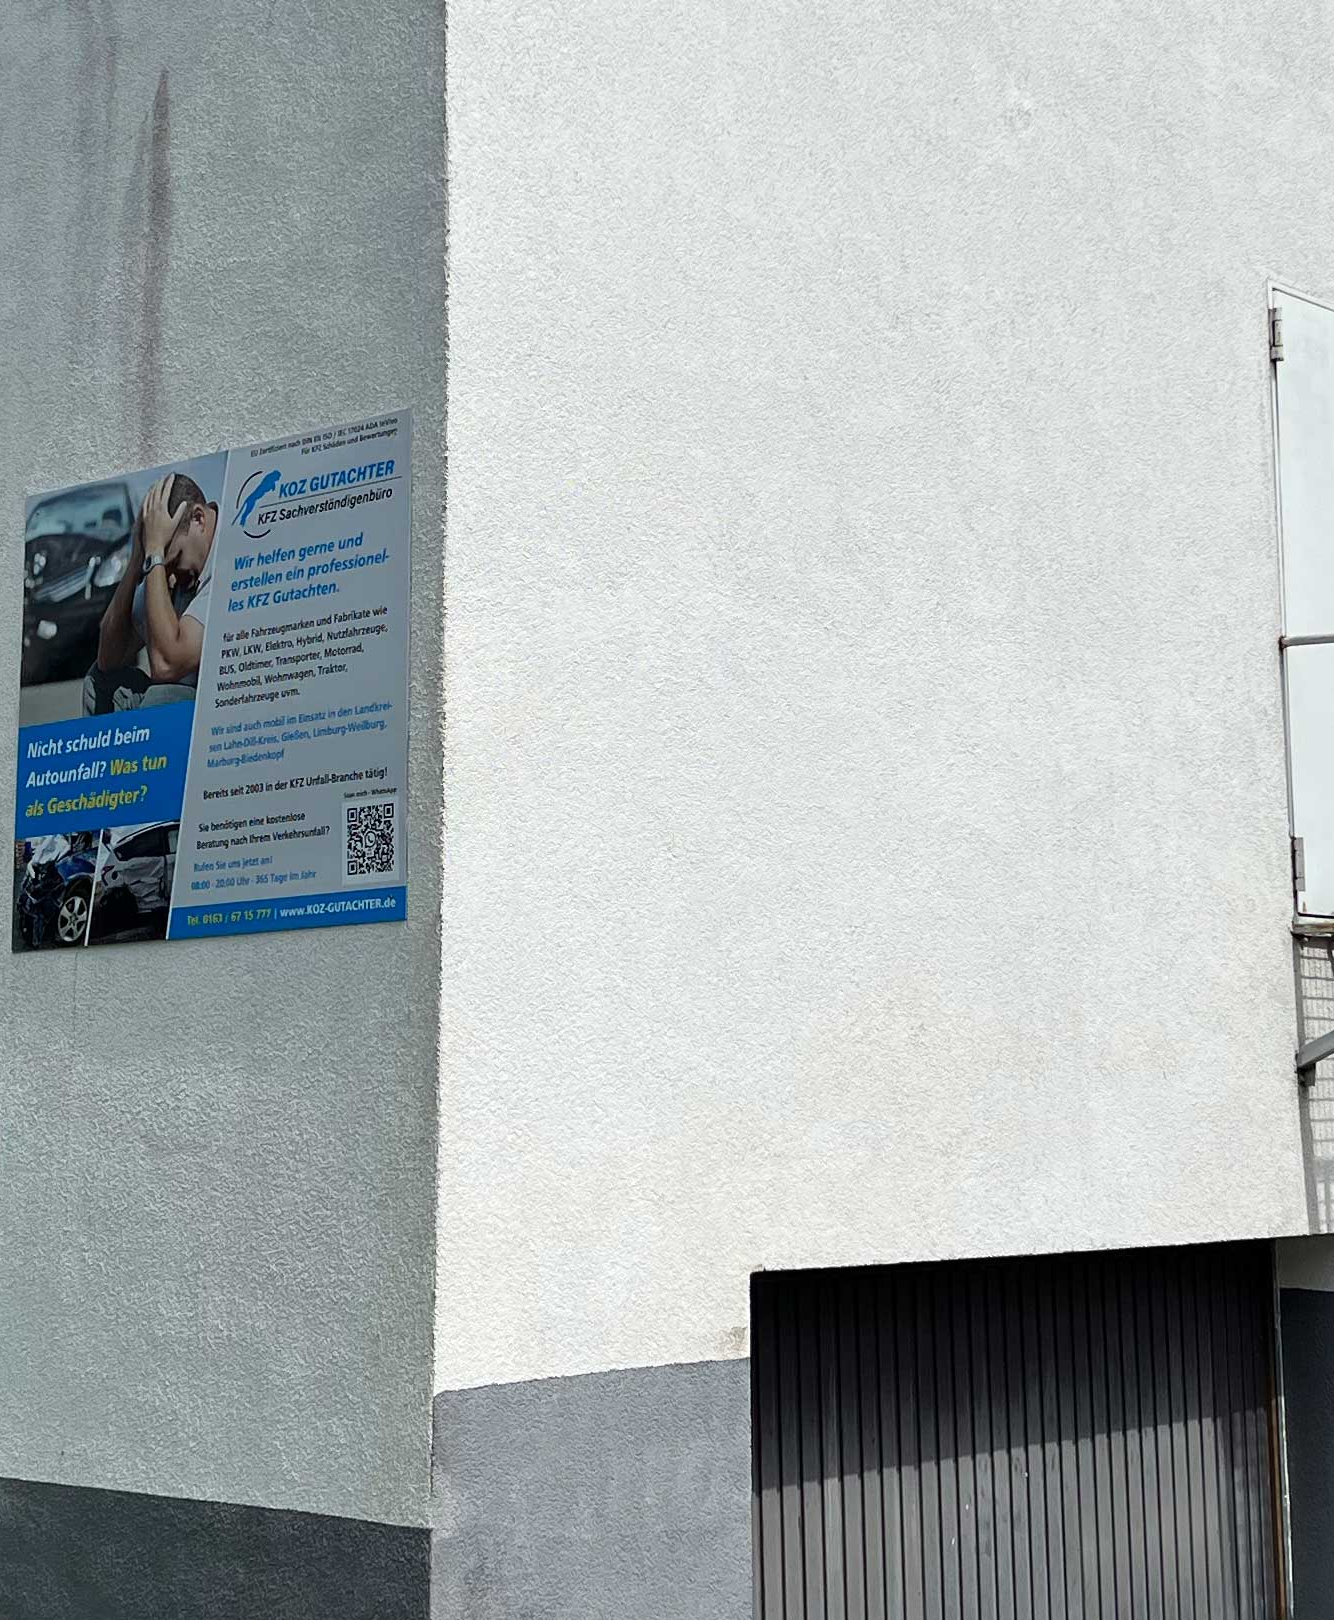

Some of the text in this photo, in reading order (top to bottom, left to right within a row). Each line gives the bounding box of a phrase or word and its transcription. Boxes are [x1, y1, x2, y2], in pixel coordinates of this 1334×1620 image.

[279, 459, 396, 498] KOZ GUTACHTER
[257, 487, 392, 526] KFZ Sachverständigenbüro
[234, 532, 364, 570] Wir helfen gerne und
[231, 548, 390, 592] erstellen ein professionel-
[228, 580, 340, 612] les KFZ Gutachten.
[223, 632, 234, 644] für
[250, 619, 315, 638] Fahrzeugmarken
[316, 616, 332, 626] und
[334, 610, 370, 624] Fabrikate
[372, 606, 388, 617] wie
[296, 632, 325, 648] Hybrid,
[214, 691, 280, 708] Sonderfahrzeuge
[298, 711, 326, 724] Einsatz
[328, 711, 336, 720] in
[338, 706, 352, 718] den
[27, 726, 150, 758] Nicht schuld beim
[26, 755, 168, 788] Autounfall? Was tun
[204, 767, 388, 800] Bereits seit 2003 in der KFZ Unfall-Branche tätig!
[26, 786, 148, 818] als Geschädigter?
[196, 826, 330, 850] Beratung nach Ihrem Verkehrsunfall?
[198, 812, 306, 833] Sie benötigen eine kostenlose
[216, 860, 226, 870] Sie
[228, 860, 240, 868] uns
[242, 856, 259, 868] jetzt
[236, 876, 250, 886] Uhr
[255, 874, 268, 884] 365
[270, 873, 288, 884] Tage
[289, 872, 300, 880] im
[188, 915, 200, 926] Tel.
[231, 911, 242, 922] 67
[244, 909, 254, 921] 15
[256, 908, 272, 919] 777
[280, 895, 396, 918] www.KOZ-GUTACHTER.de
